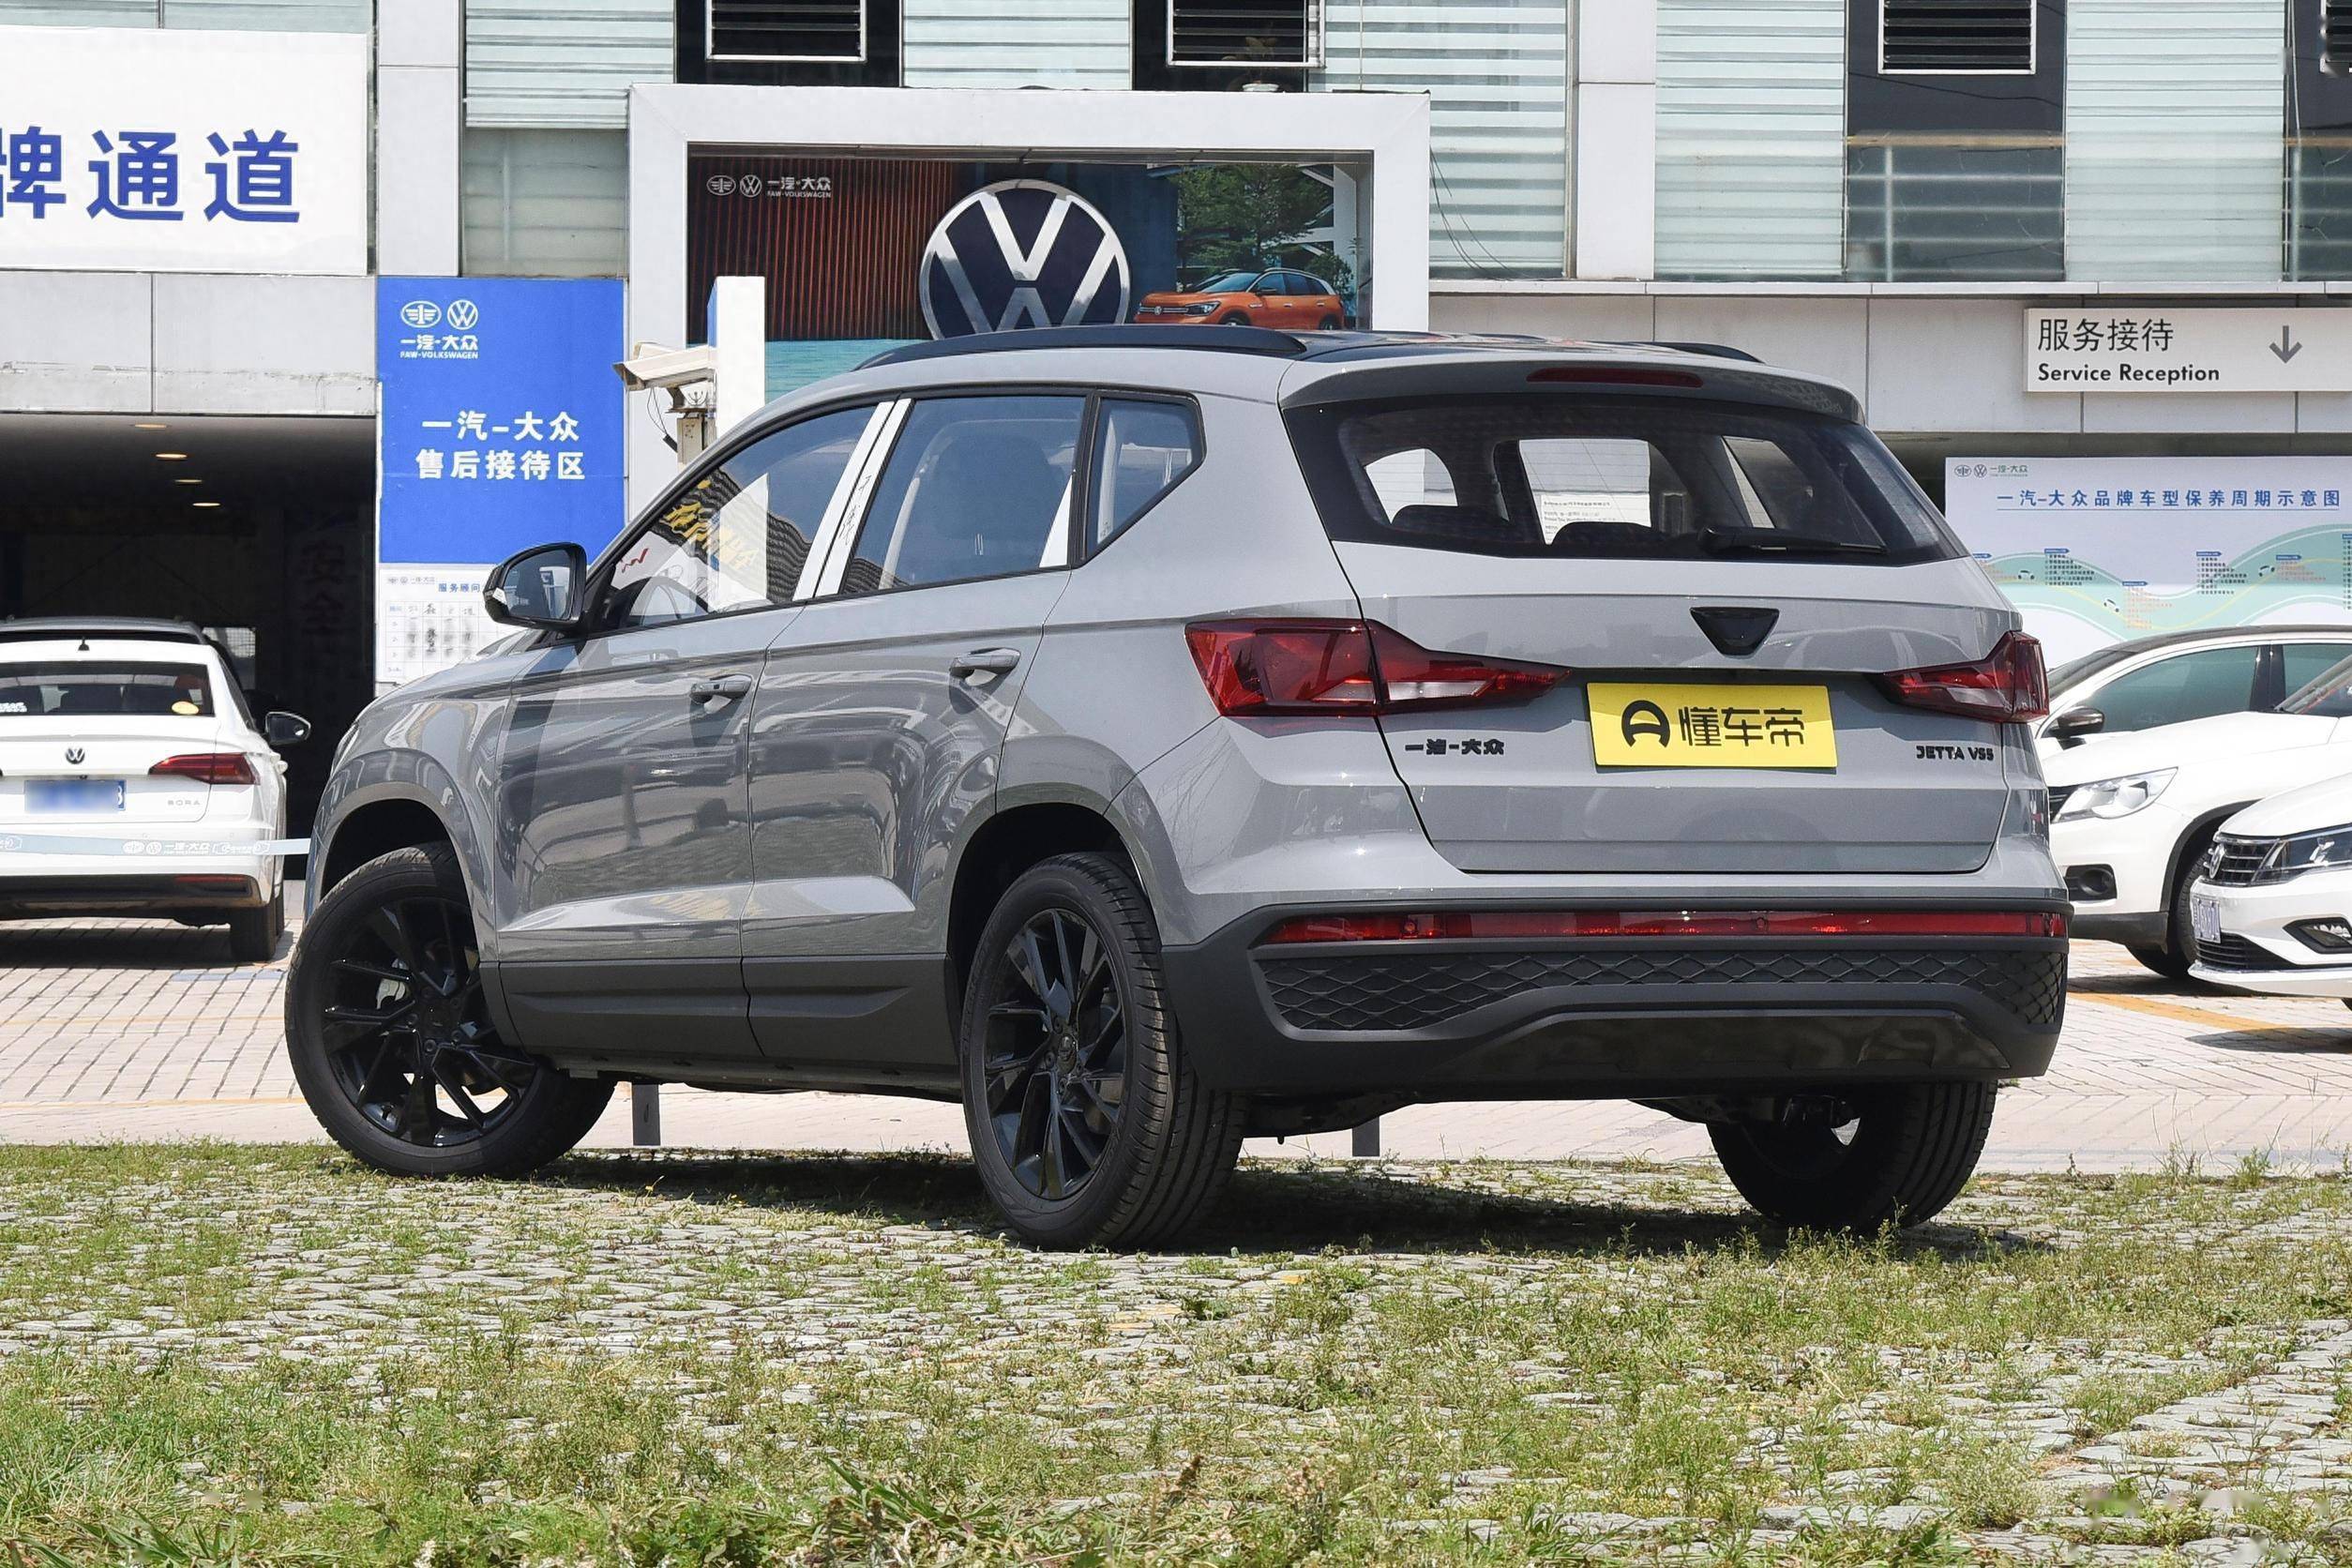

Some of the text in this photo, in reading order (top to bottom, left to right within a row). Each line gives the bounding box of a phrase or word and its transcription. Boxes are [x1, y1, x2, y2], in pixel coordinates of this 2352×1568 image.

[2038, 318, 2174, 352] 服务接待
[400, 351, 478, 359] FAW-VOLKSWAGEN
[2038, 362, 2220, 385] Service Reception
[415, 449, 585, 480] 售后接待区
[1678, 706, 1805, 747] 懂车帝
[1916, 745, 1995, 761] JETTA VS5
